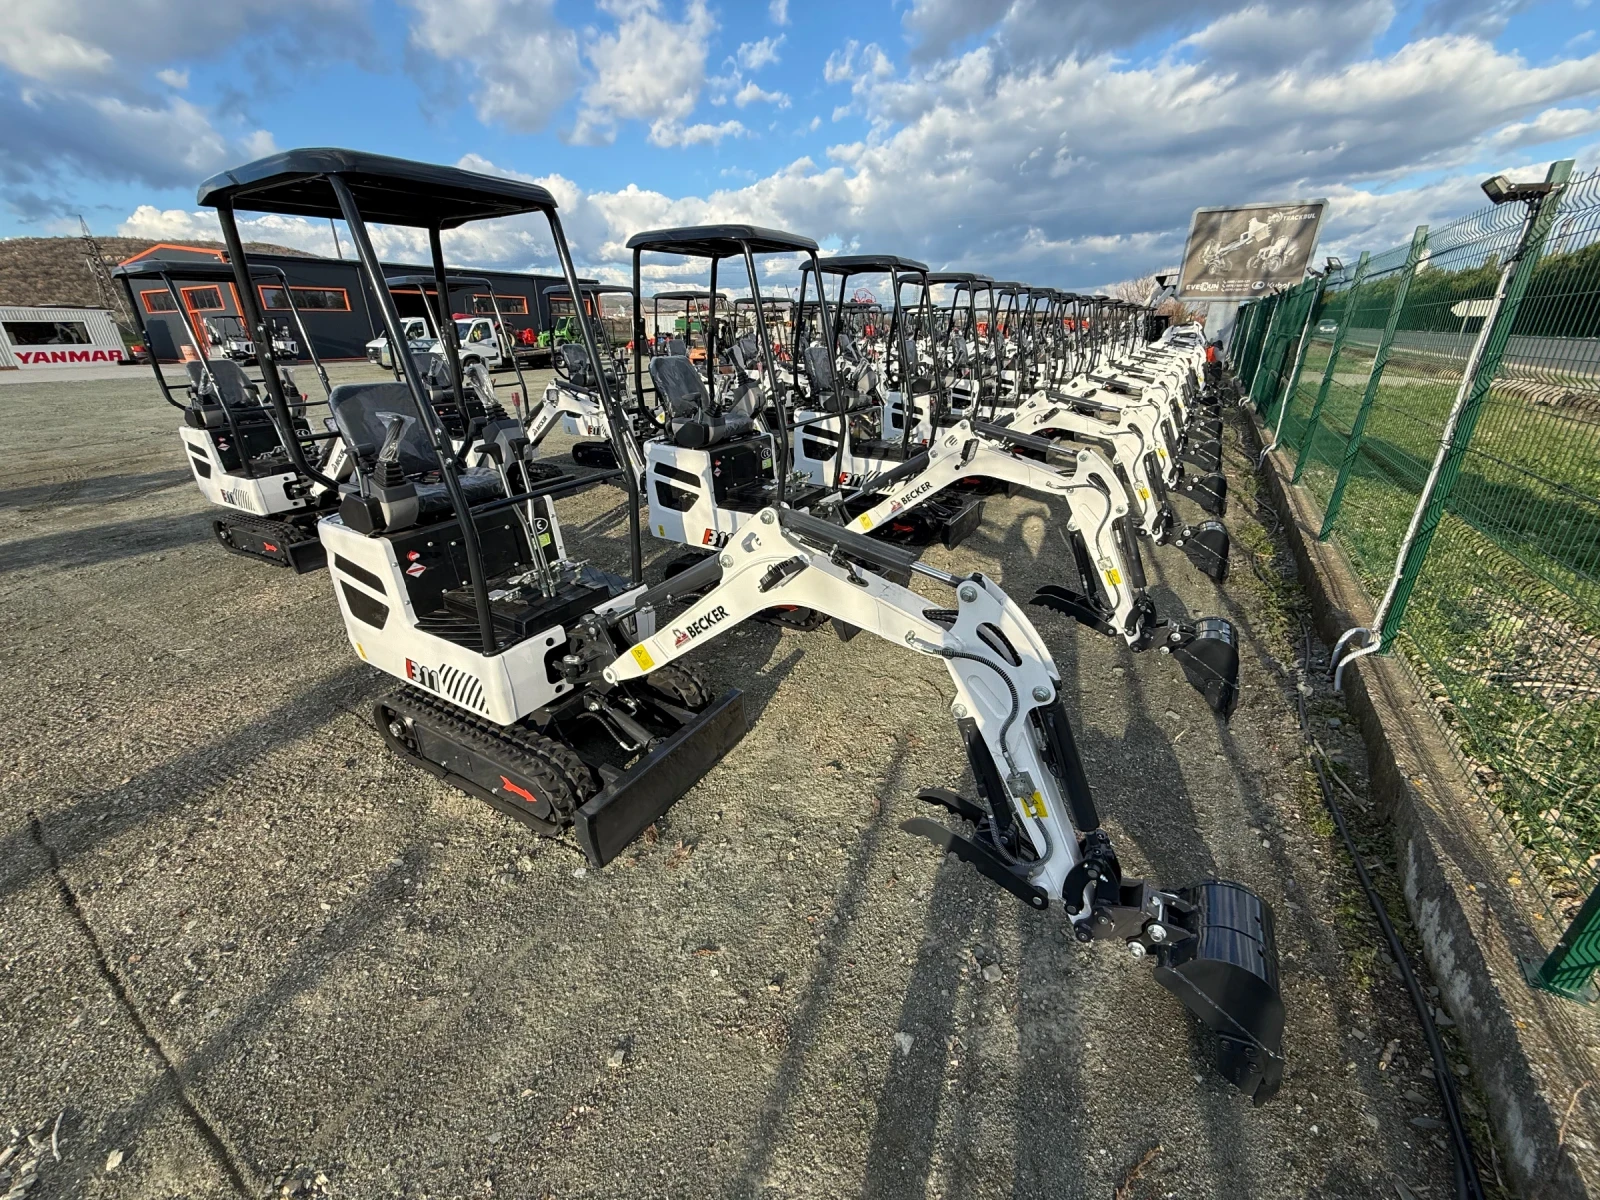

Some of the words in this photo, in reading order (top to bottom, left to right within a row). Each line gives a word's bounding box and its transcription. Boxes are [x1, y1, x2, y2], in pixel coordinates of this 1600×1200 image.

[14, 350, 123, 364] YANMAR
[900, 481, 933, 505] BECKER
[686, 605, 730, 638] BECKER
